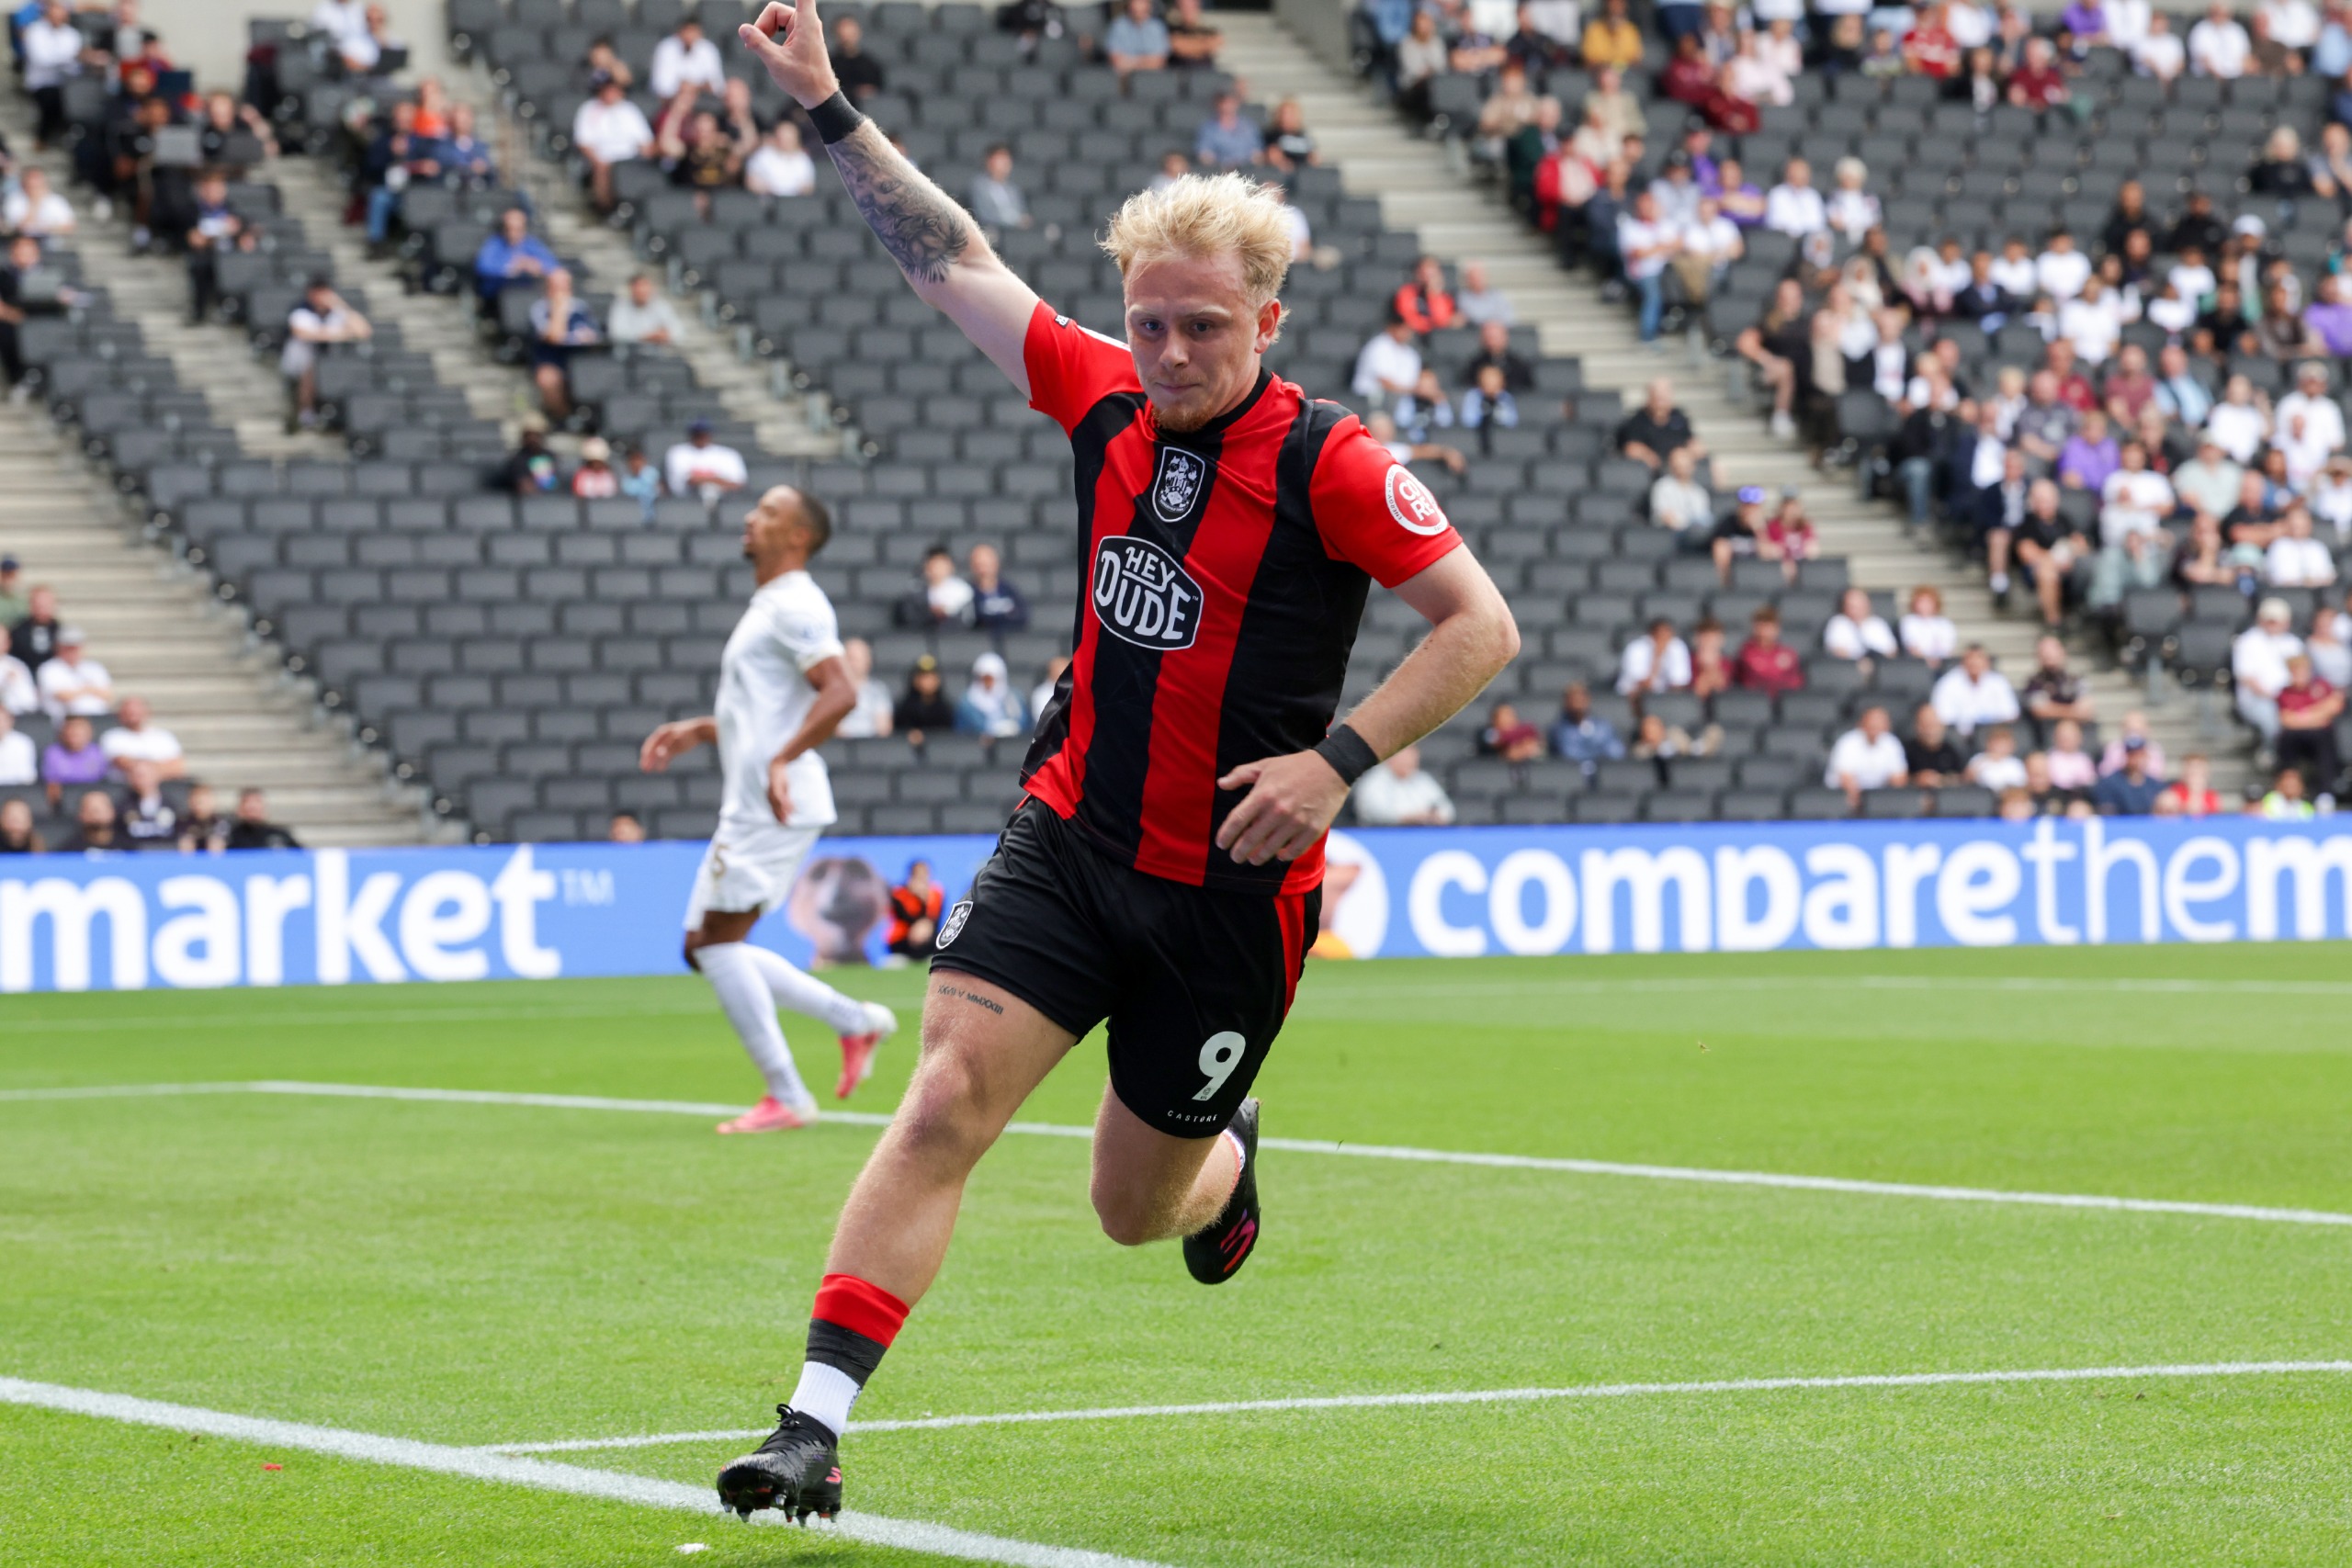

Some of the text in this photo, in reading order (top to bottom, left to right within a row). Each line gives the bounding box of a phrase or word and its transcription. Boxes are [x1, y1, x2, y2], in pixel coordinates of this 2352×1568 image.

[1095, 550, 1192, 639] DUDE
[1122, 546, 1176, 592] HEY
[0, 842, 562, 993] market
[1192, 1031, 1246, 1101] 9
